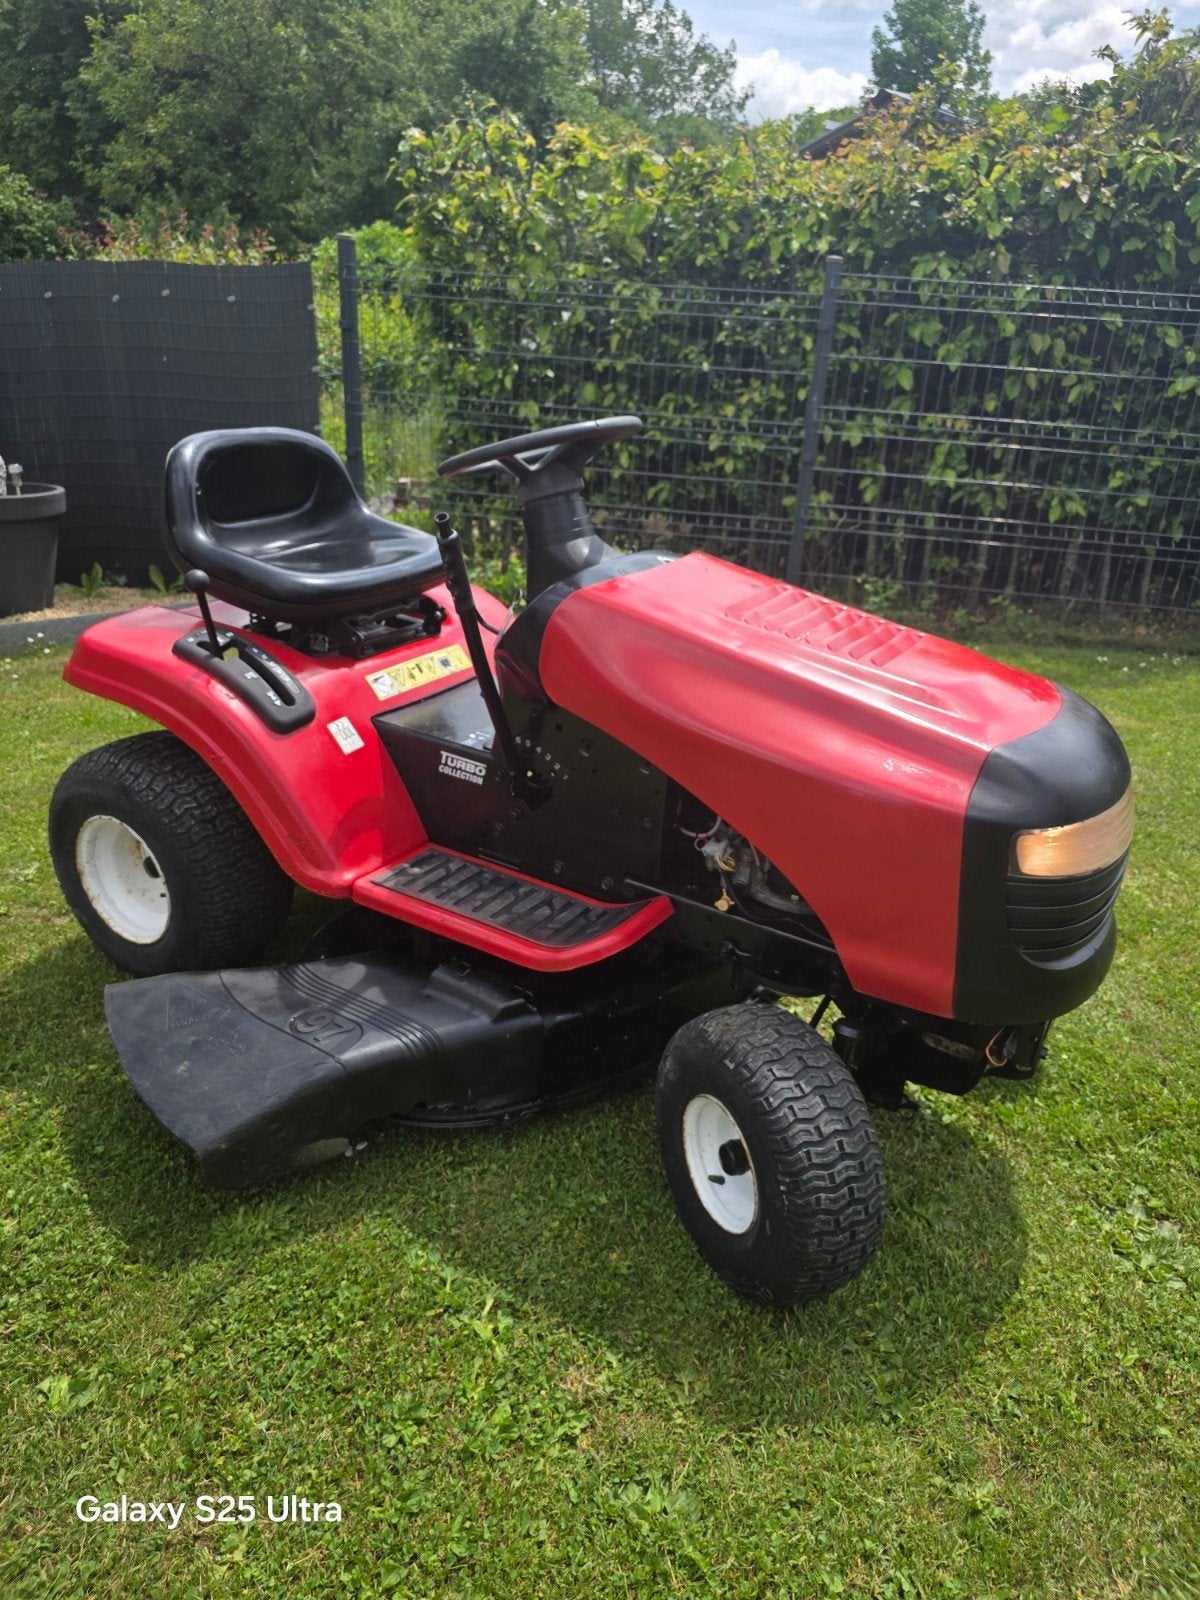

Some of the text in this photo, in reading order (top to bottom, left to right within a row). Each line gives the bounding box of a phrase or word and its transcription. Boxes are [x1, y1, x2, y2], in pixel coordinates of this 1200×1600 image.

[440, 750, 487, 775] TURBO
[544, 752, 552, 761] 3
[553, 762, 561, 771] 2
[438, 764, 484, 785] COLLECTION
[296, 1010, 357, 1042] 97
